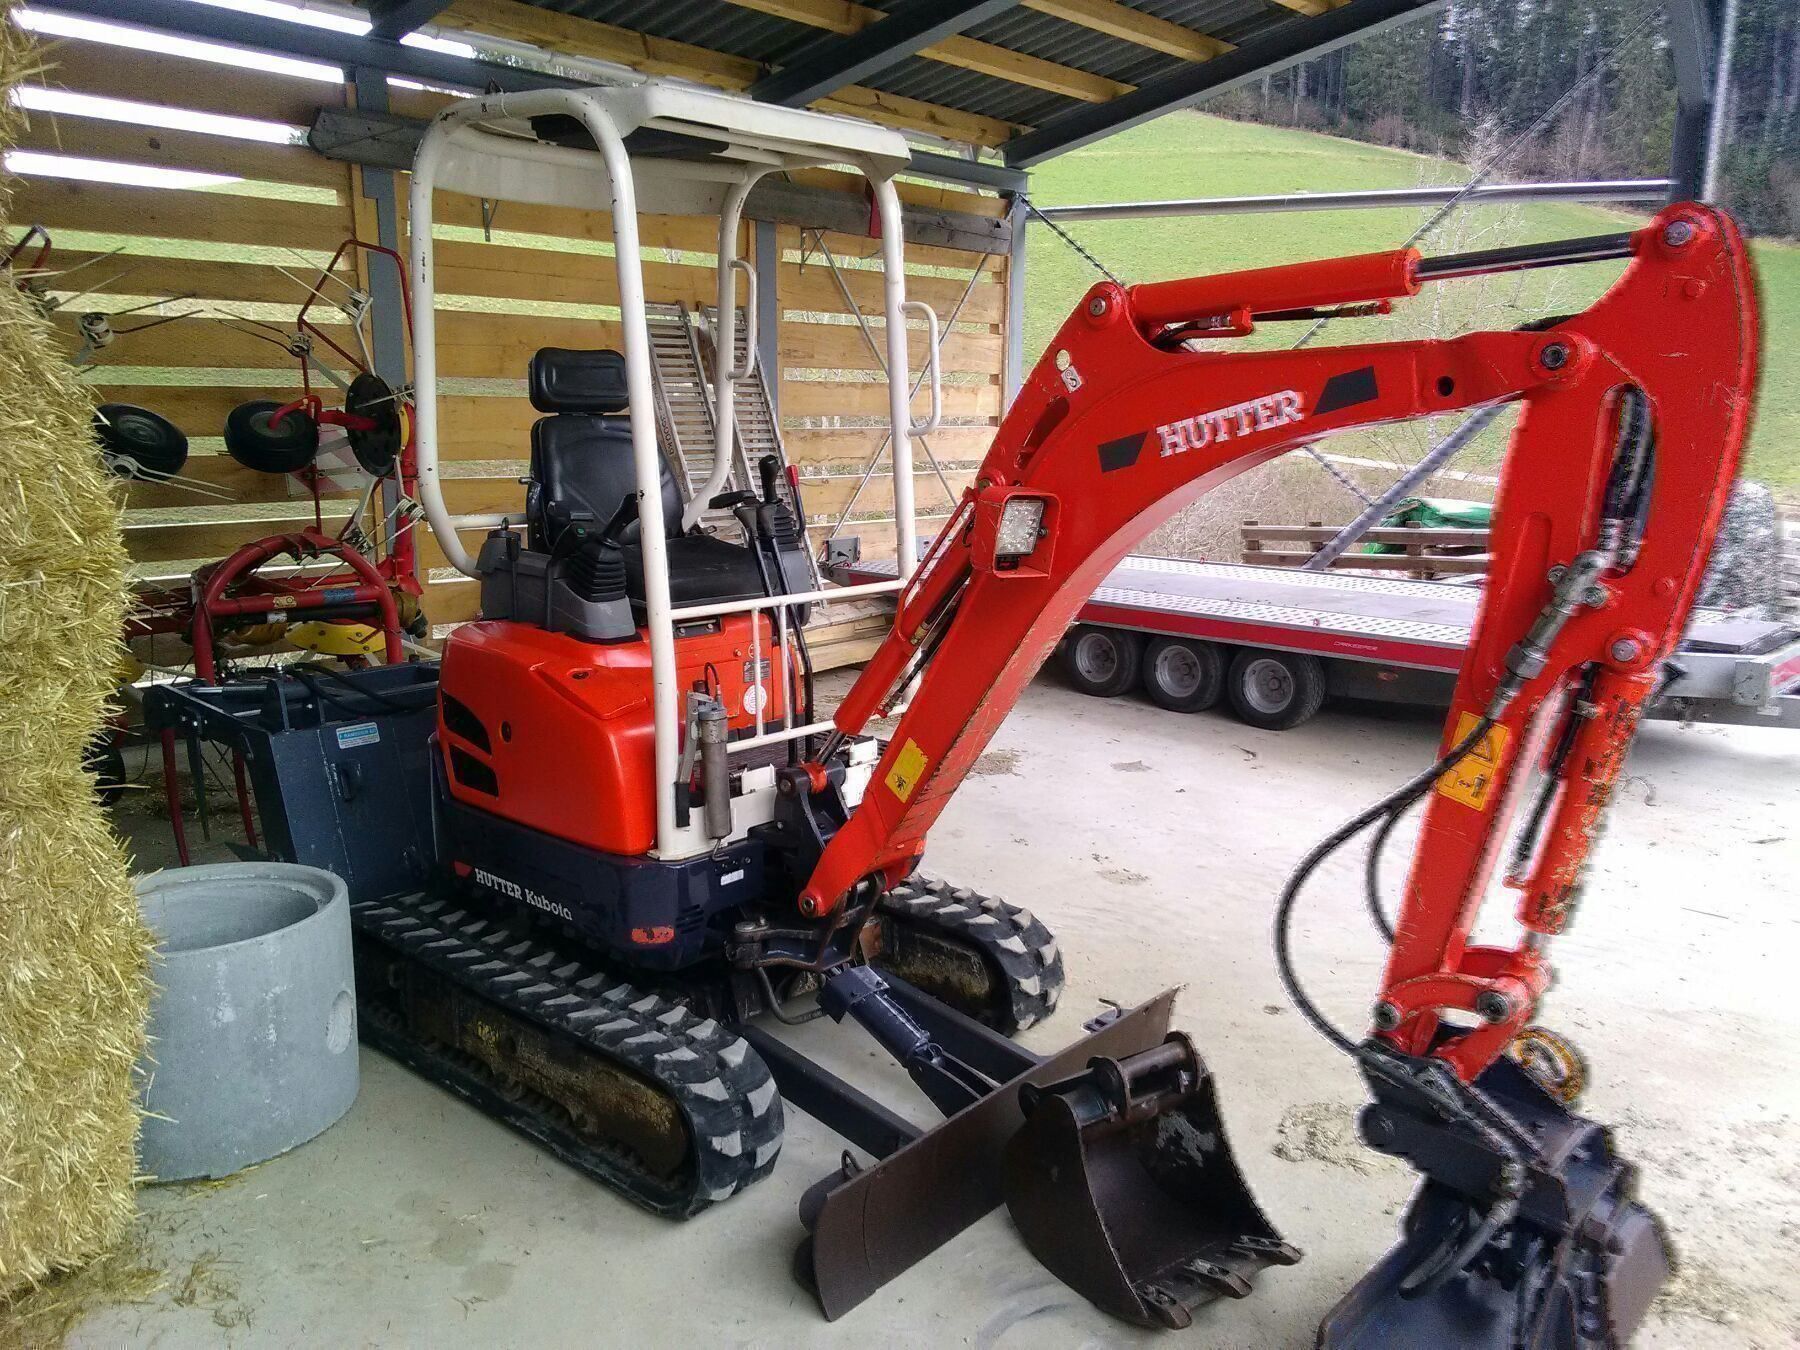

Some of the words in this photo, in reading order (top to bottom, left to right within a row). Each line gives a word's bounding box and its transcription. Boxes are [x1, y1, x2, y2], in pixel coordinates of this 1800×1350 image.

[1156, 389, 1304, 457] HUTTER
[475, 867, 522, 900] HUTTER
[524, 888, 572, 920] Kubota
